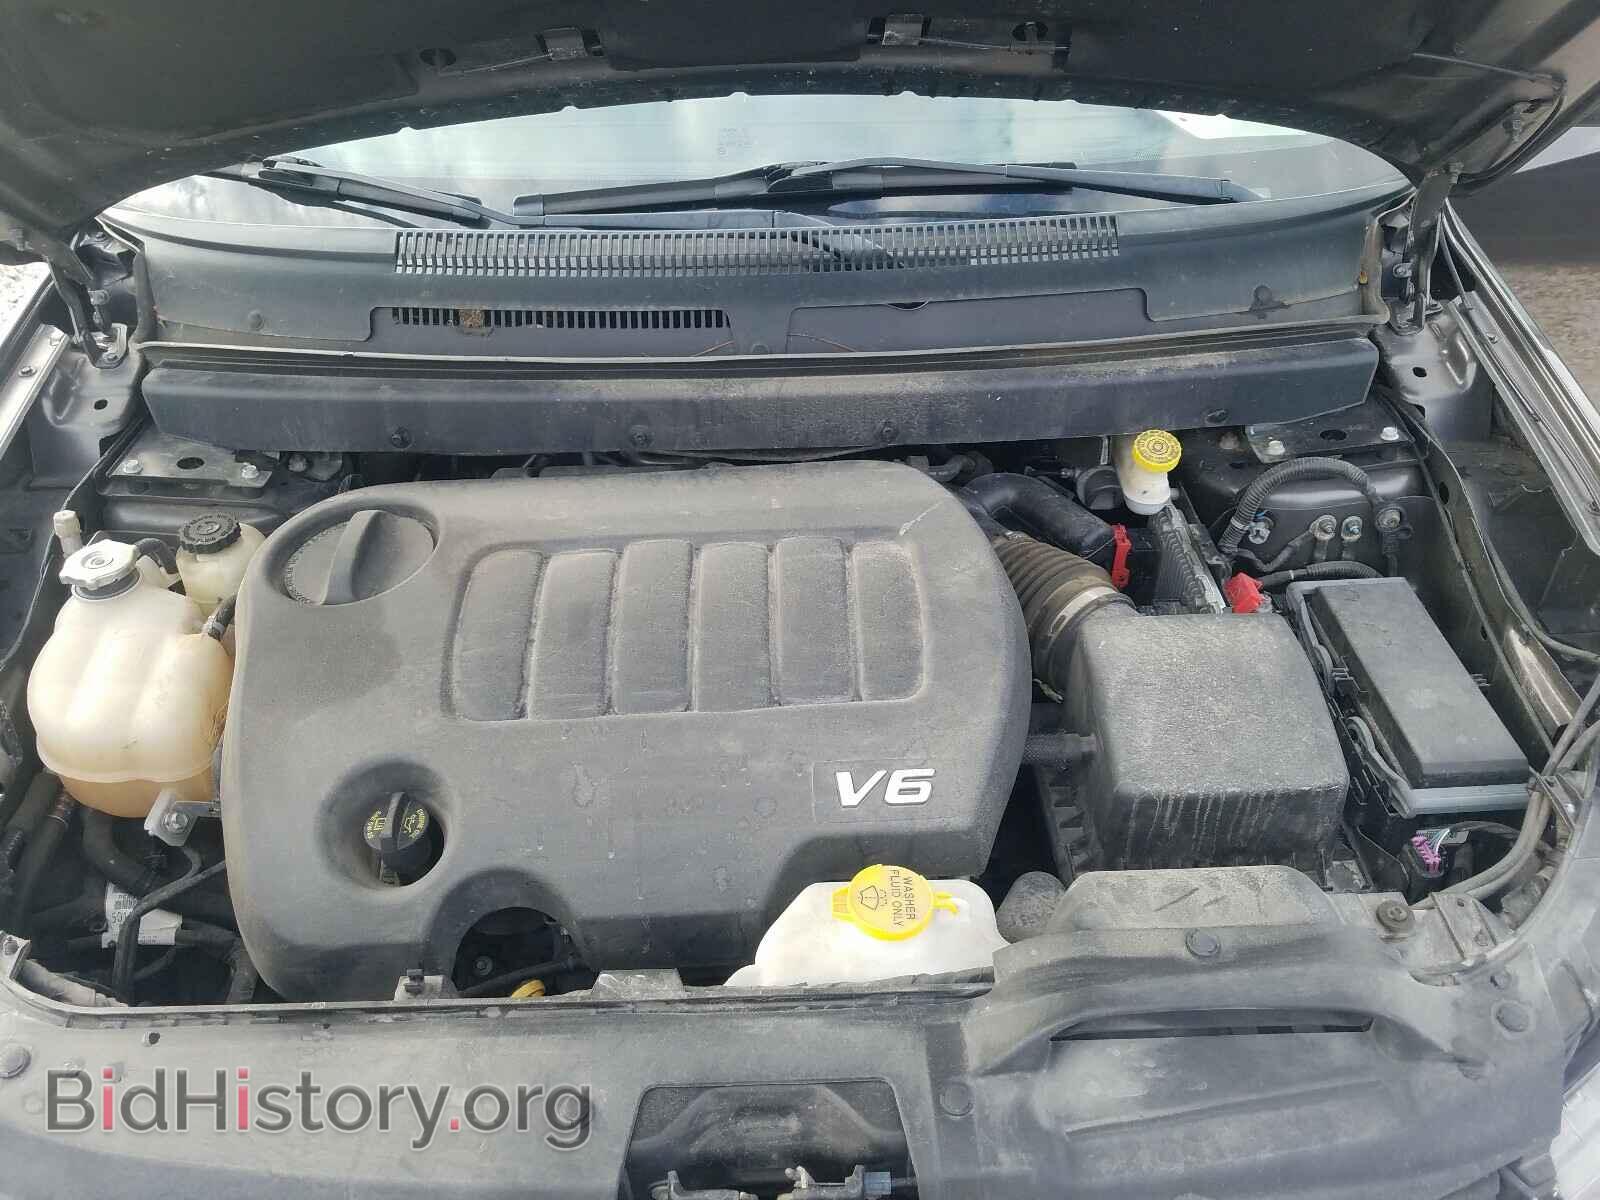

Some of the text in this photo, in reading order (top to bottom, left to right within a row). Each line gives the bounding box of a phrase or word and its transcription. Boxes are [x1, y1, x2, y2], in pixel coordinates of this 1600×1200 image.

[835, 768, 936, 808] V6
[889, 869, 905, 928] FLUID ONLY
[903, 876, 916, 920] WASHER
